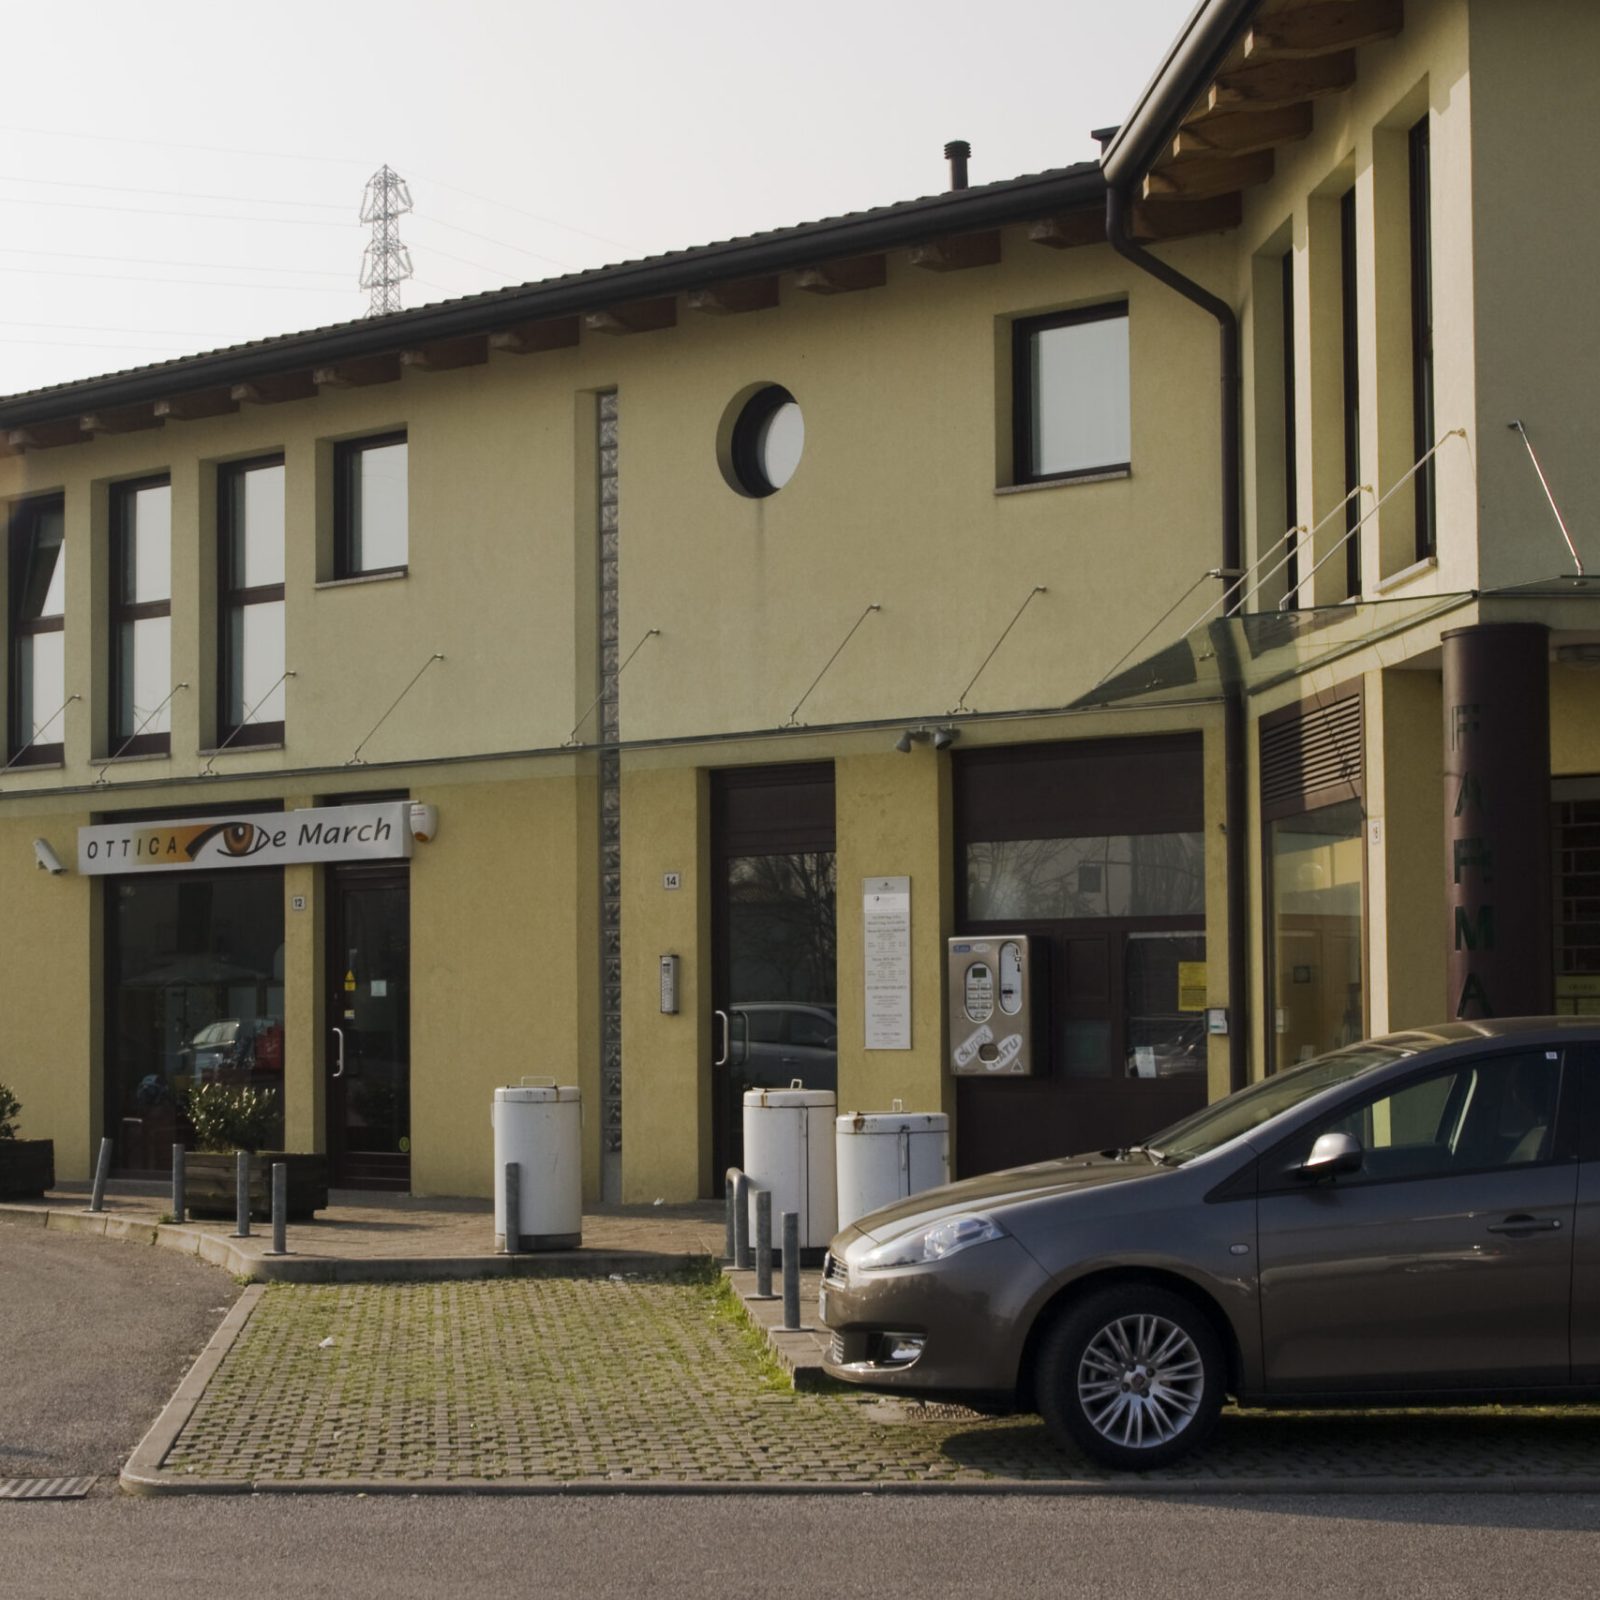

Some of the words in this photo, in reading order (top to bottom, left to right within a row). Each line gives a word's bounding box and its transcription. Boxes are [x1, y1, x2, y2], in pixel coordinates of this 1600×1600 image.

[88, 835, 177, 860] OTTICA
[255, 824, 287, 850] De
[298, 817, 392, 846] March
[666, 875, 677, 886] 14
[294, 898, 303, 908] 12
